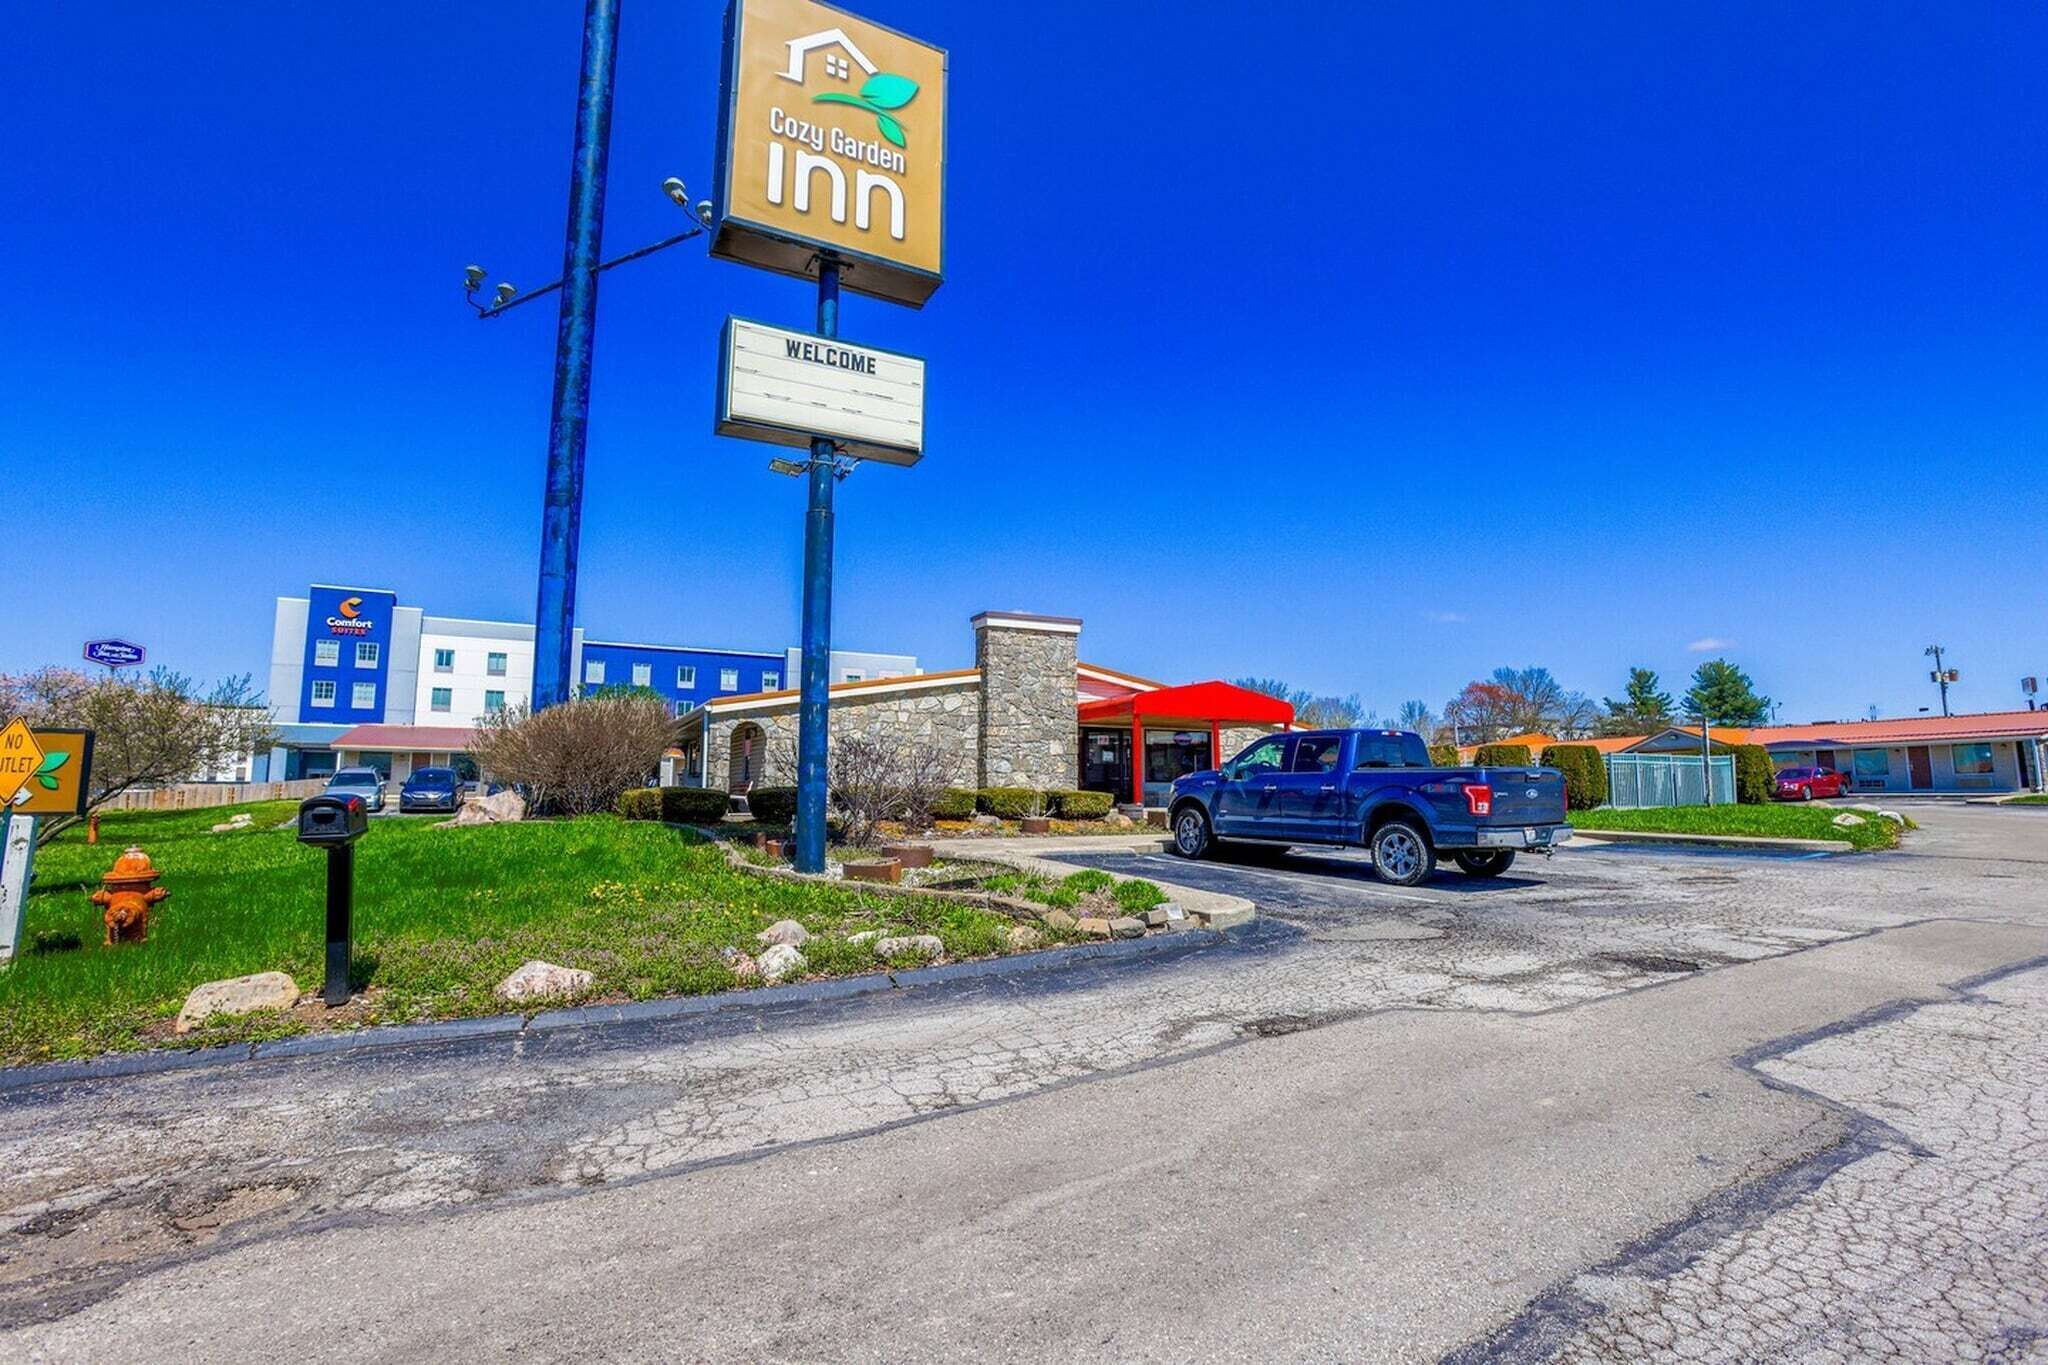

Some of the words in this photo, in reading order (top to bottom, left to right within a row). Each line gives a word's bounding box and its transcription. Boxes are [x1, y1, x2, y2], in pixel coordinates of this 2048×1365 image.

[769, 106, 825, 153] Cozy
[830, 127, 906, 174] Garden
[785, 338, 877, 375] WELCOME
[326, 616, 373, 629] Comfort
[4, 733, 24, 749] NO
